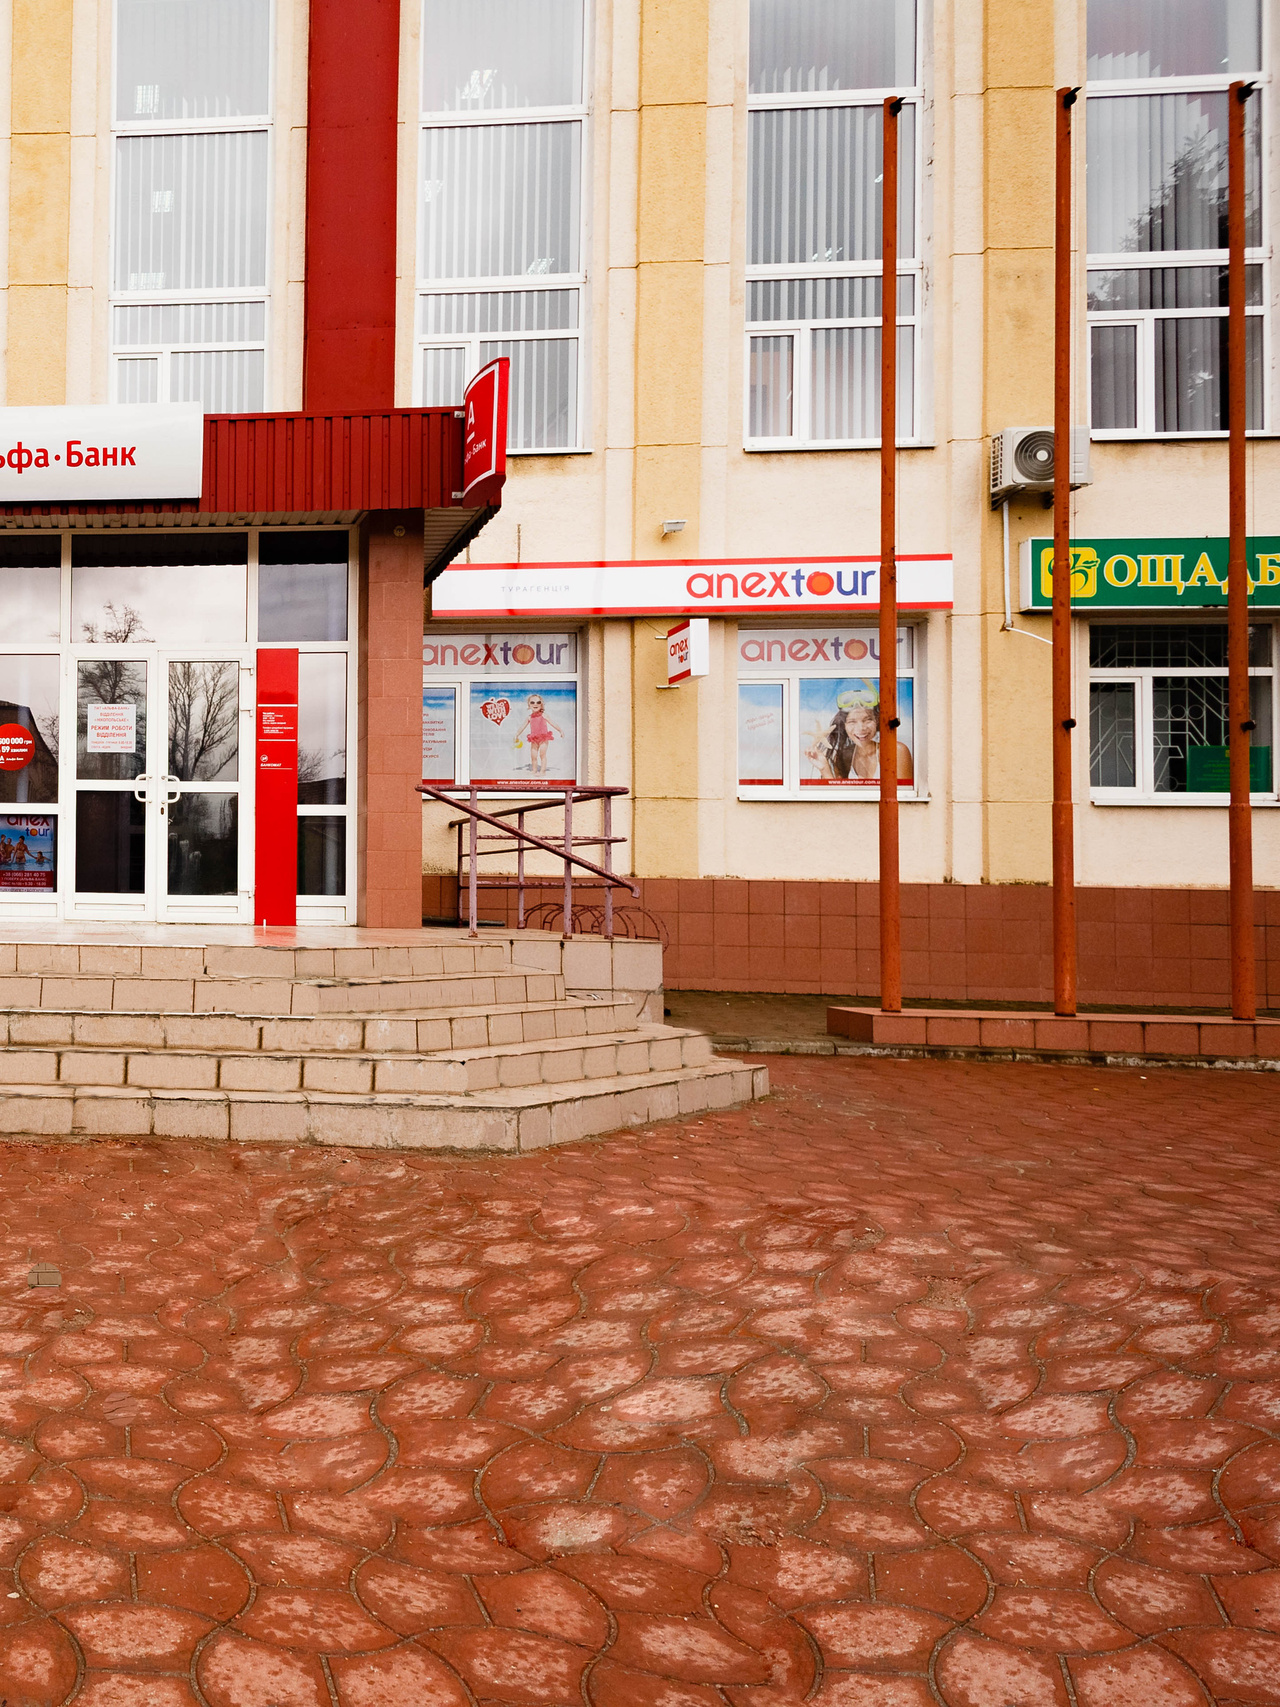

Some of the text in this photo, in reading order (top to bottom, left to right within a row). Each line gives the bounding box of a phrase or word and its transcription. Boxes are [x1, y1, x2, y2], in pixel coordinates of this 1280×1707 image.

[501, 585, 570, 593] ТУРАГЕНЦІЯ
[686, 568, 876, 599] anextour
[670, 638, 688, 657] anex
[25, 827, 50, 837] tour
